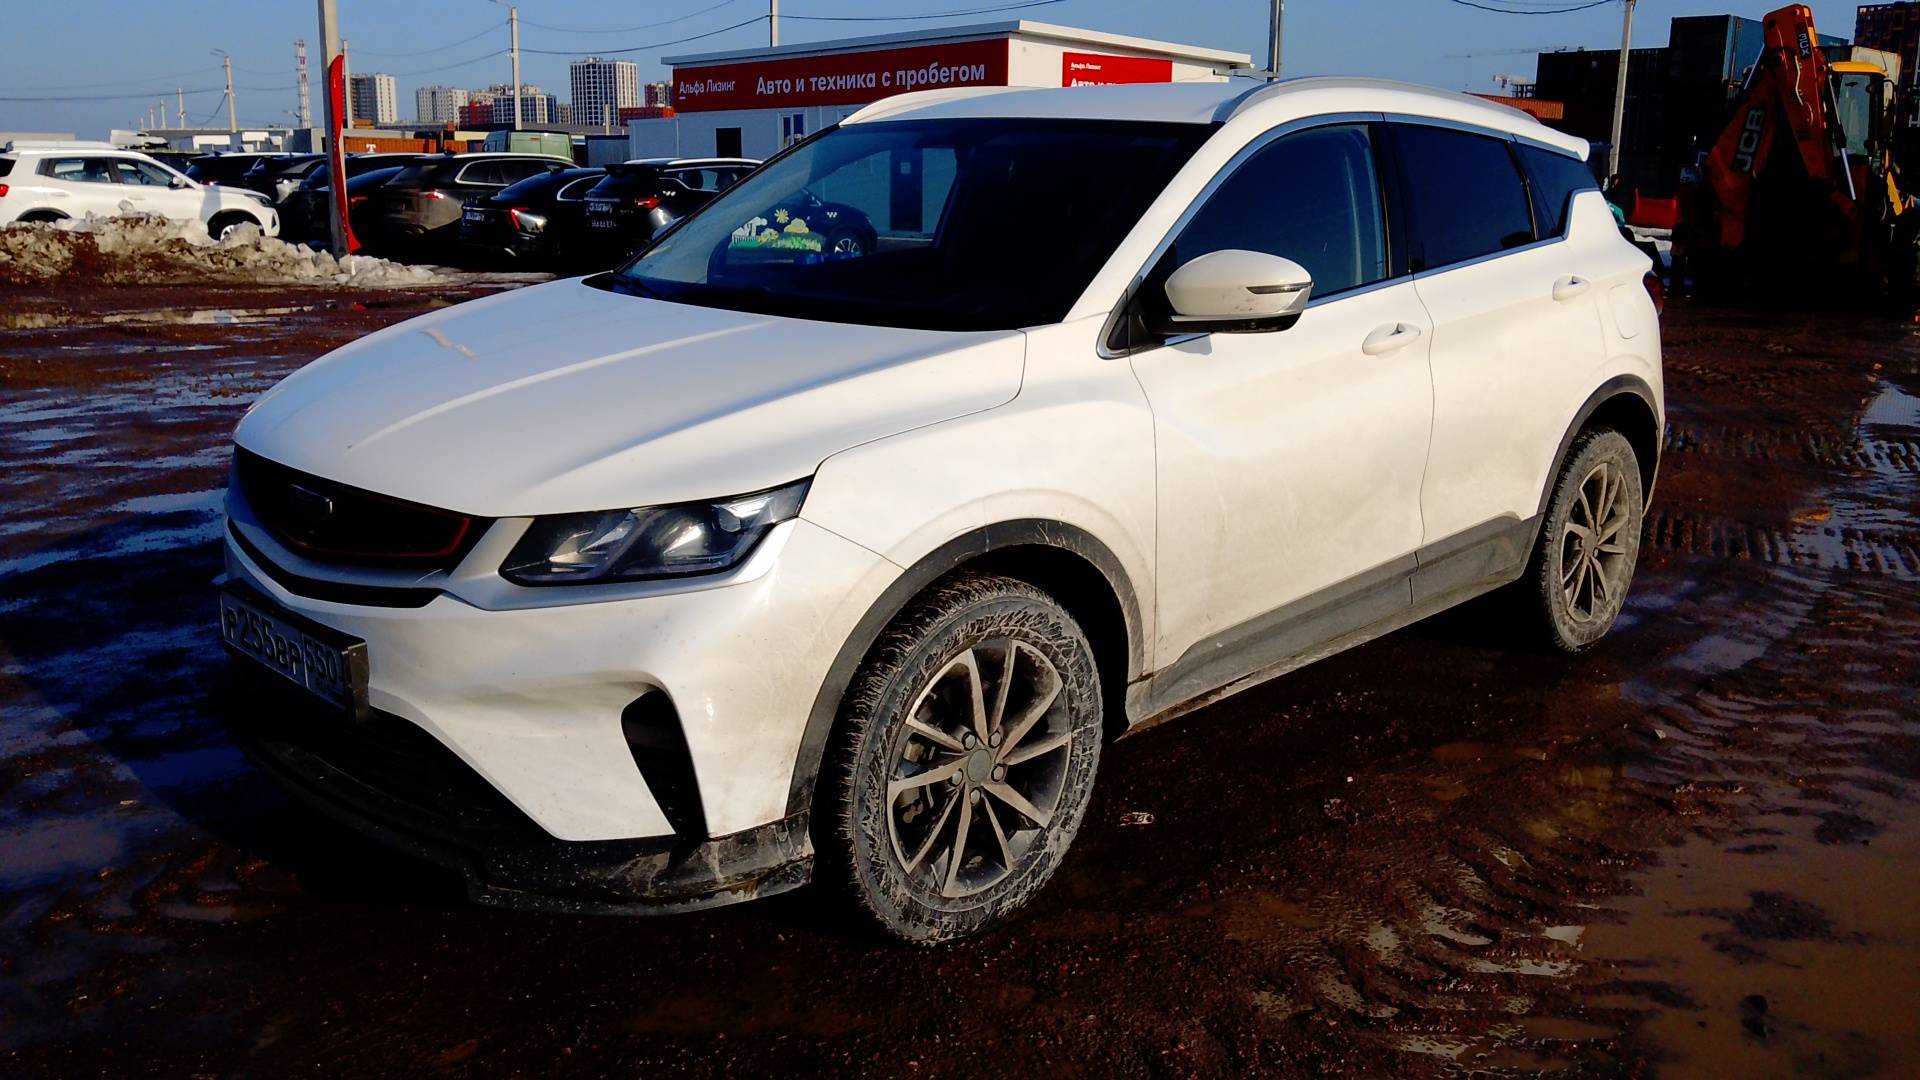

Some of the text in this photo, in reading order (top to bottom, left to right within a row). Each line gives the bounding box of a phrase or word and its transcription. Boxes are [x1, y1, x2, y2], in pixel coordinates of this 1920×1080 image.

[1799, 33, 1811, 57] 3CX
[679, 79, 736, 97] Альфа Лизинг
[756, 62, 986, 95] Авто и техника с пробегом
[1737, 108, 1766, 171] JCB
